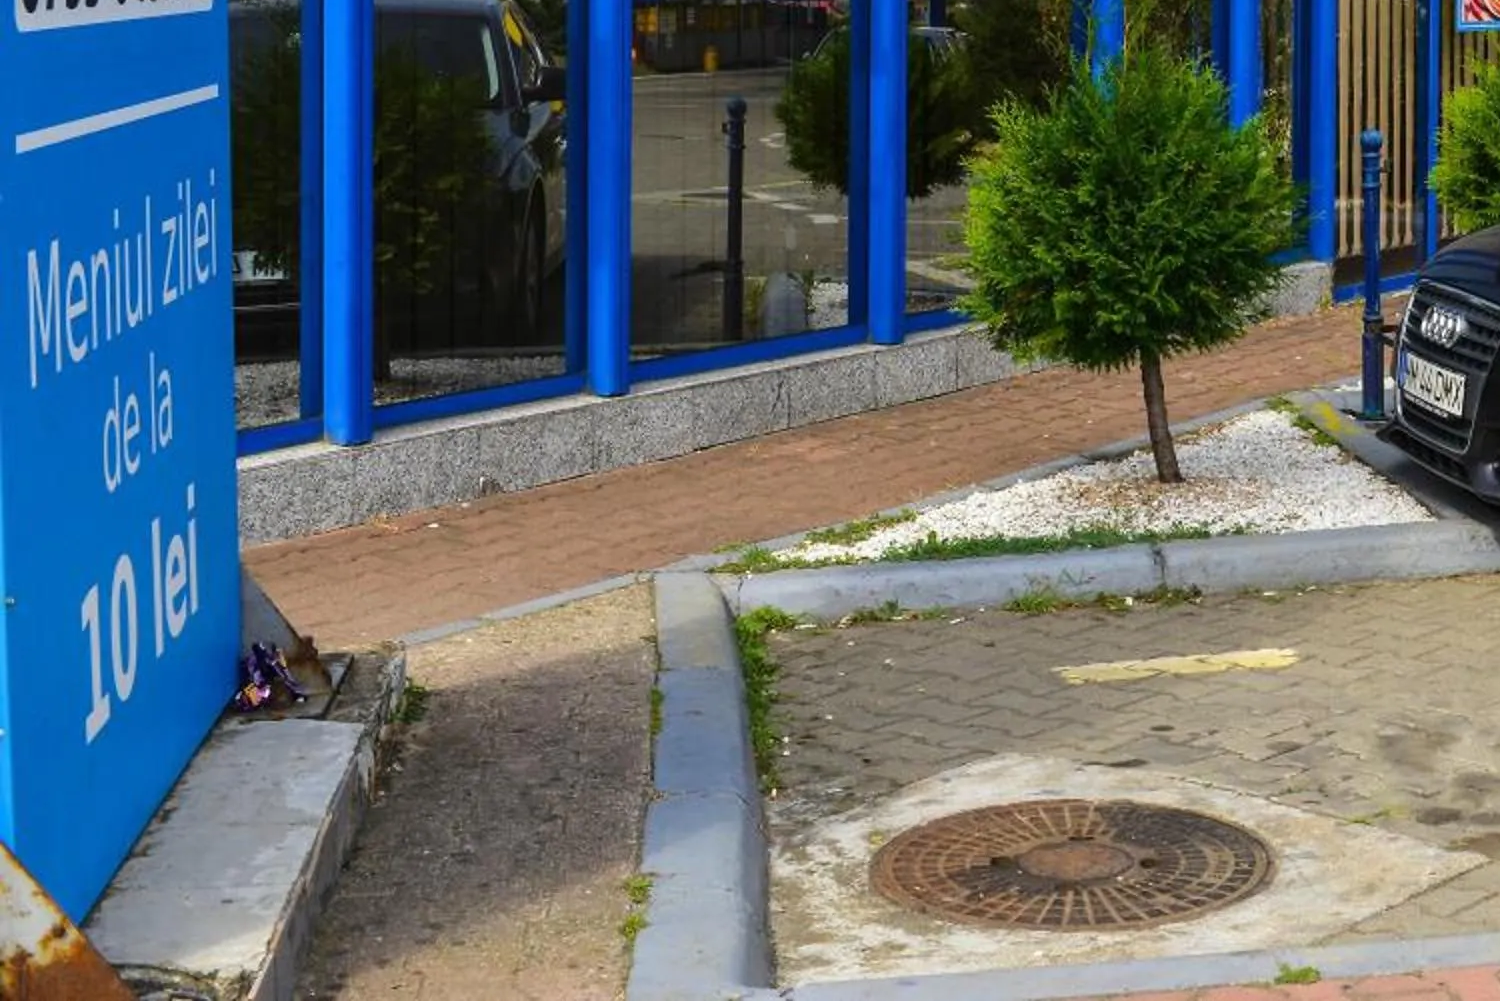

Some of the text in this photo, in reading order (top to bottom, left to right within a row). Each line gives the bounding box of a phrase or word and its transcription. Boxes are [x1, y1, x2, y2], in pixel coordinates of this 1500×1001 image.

[27, 167, 218, 389] Meniul zilei
[102, 351, 173, 494] de la
[81, 482, 199, 746] 10 lei
